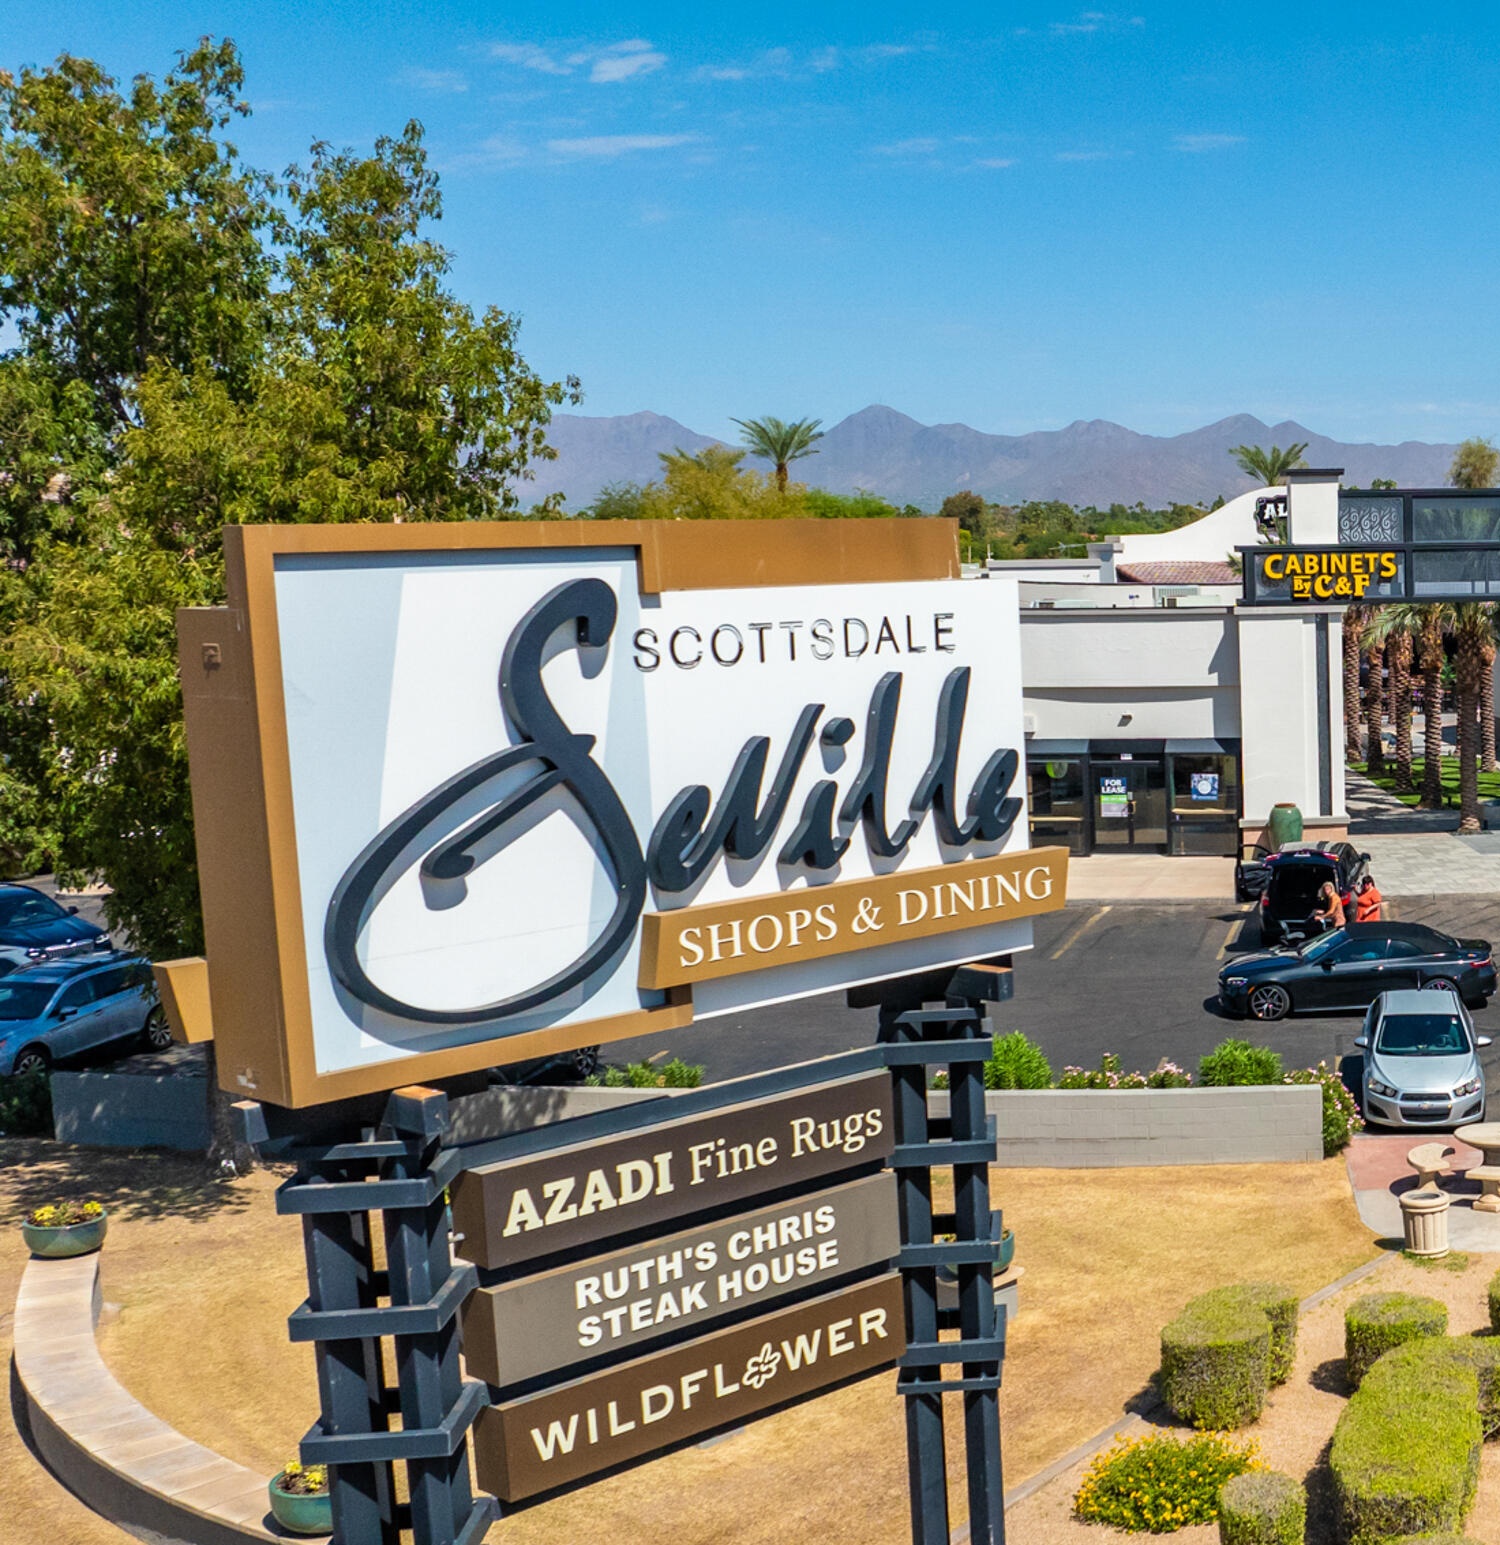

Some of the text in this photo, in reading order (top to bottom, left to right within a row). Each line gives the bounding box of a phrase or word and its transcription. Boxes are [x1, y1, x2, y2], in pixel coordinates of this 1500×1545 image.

[1264, 503, 1287, 519] AL
[1263, 552, 1397, 579] CABINETS
[1293, 574, 1370, 598] By C&F
[632, 613, 956, 673] SCOTTSDALE
[678, 866, 1053, 967] SHOPS & DINING
[502, 1108, 884, 1237] AZADI Fine Rugs
[575, 1205, 836, 1310] RUTH'S CHRIS
[577, 1239, 840, 1348] STEAK HOUSE
